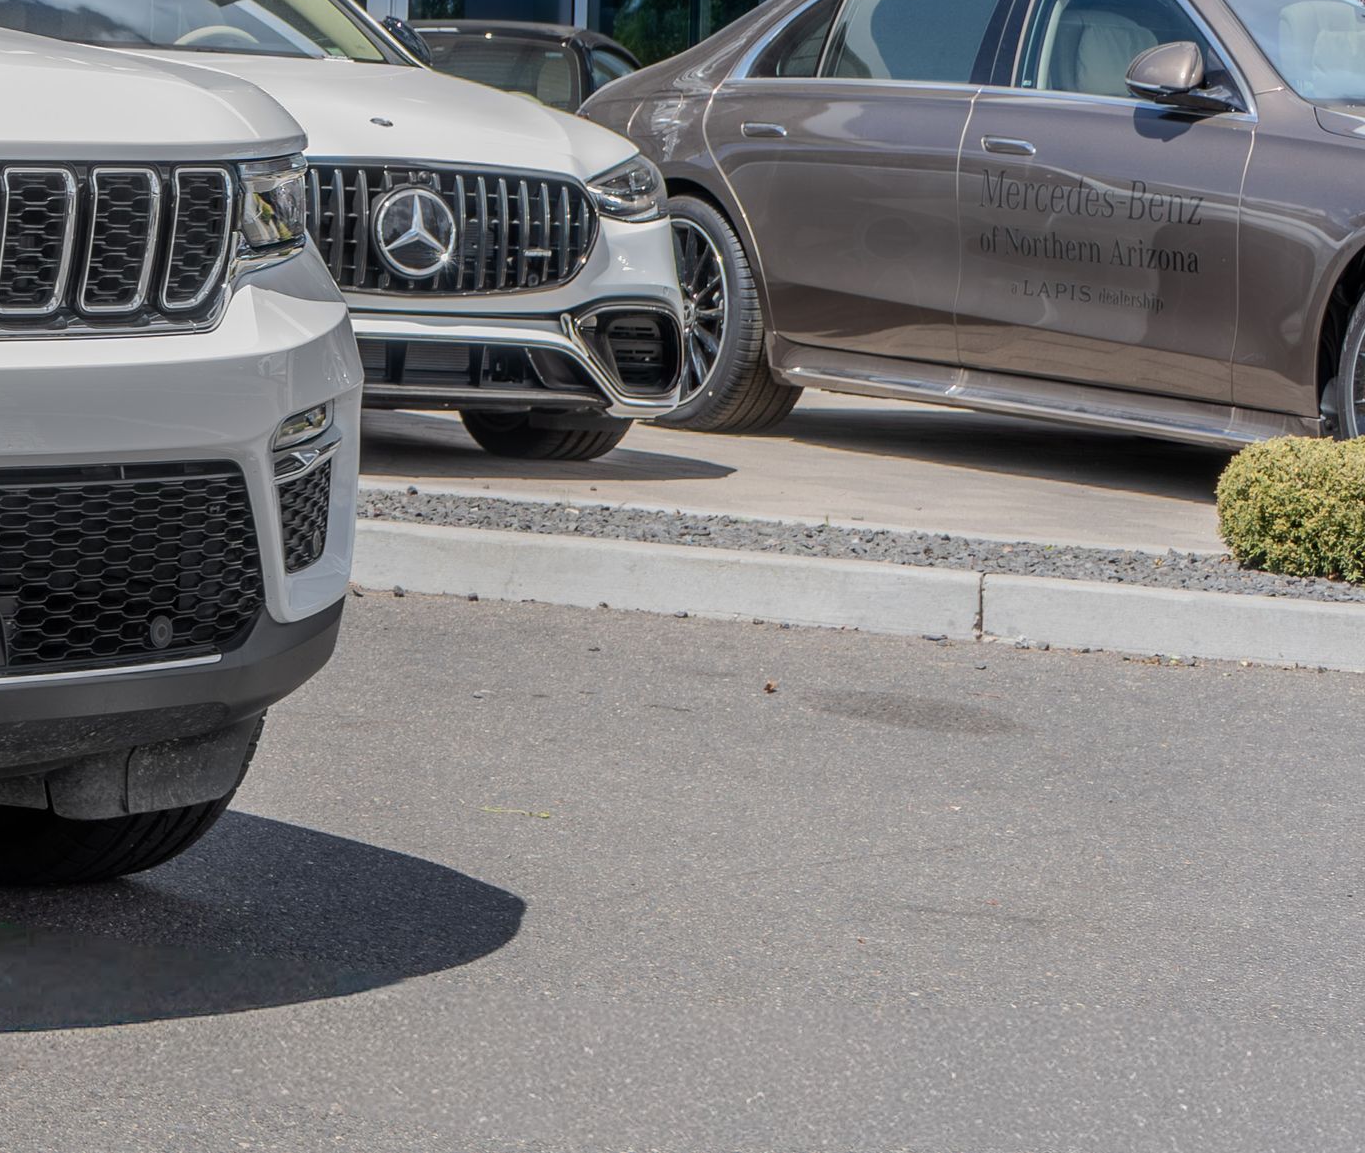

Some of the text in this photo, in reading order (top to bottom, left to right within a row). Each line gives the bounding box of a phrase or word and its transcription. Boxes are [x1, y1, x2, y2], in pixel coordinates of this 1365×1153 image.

[979, 169, 1204, 226] Mercedes-Benz
[980, 225, 1200, 274] of Northern Arizona
[1011, 280, 1164, 314] a LAPIS dealership
